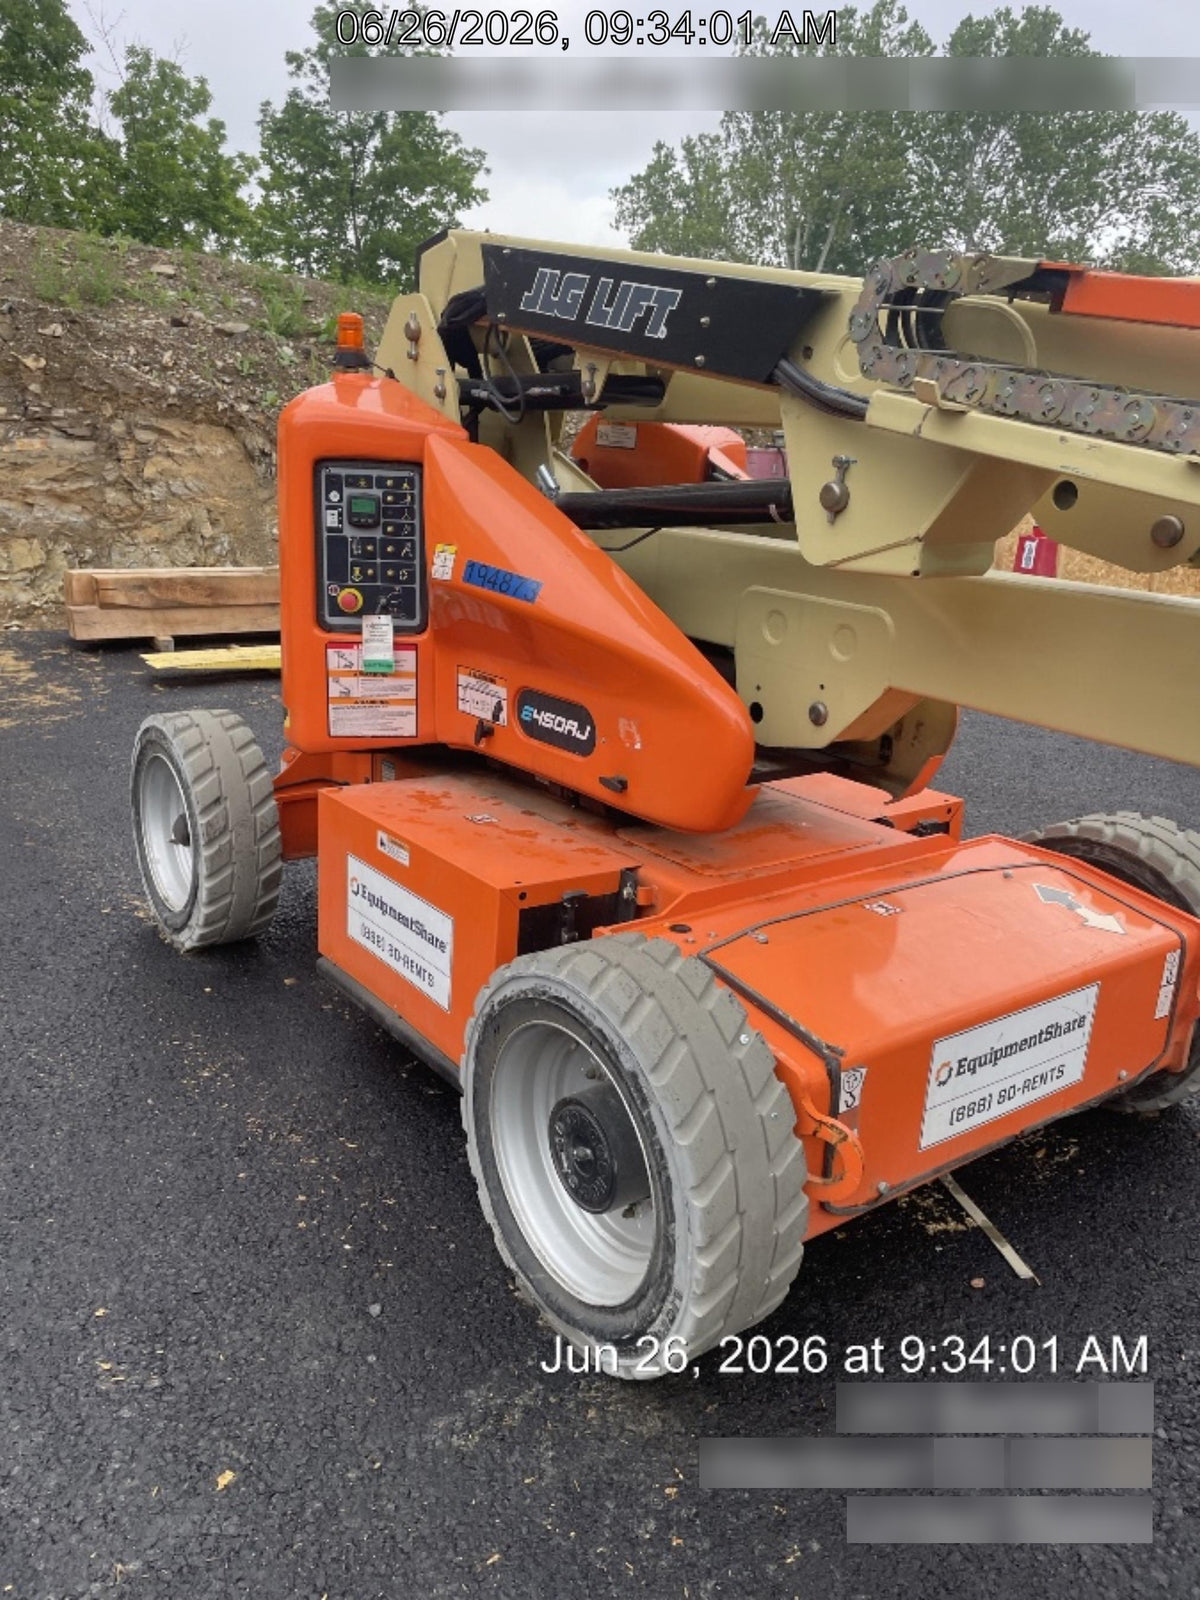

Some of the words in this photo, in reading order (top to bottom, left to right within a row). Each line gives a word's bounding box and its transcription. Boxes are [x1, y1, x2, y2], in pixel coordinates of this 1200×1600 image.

[519, 268, 591, 320] JLG
[585, 277, 683, 340] LIFT
[360, 884, 448, 954] EquipmentShare
[954, 1014, 1088, 1078] EquipmentShare
[949, 1093, 993, 1126] (888)
